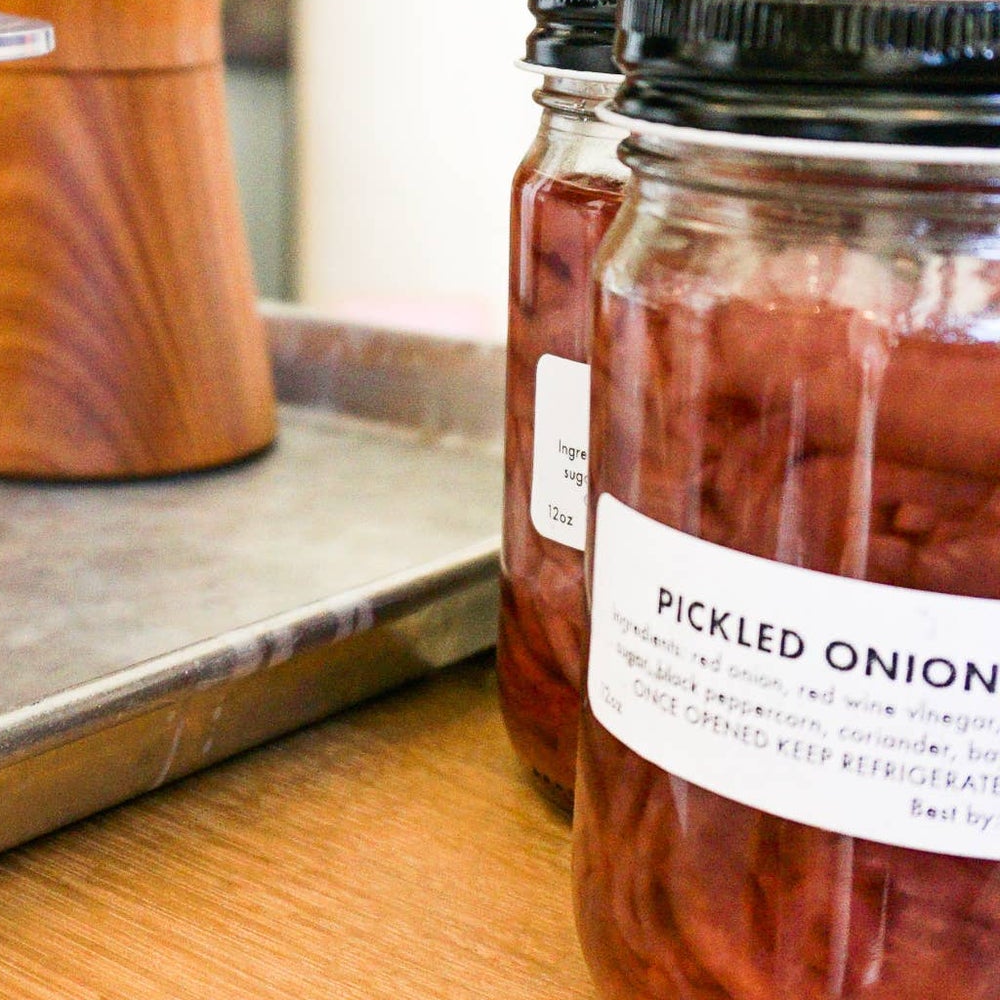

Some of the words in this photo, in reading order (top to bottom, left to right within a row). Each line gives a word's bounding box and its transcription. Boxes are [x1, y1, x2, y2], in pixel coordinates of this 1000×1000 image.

[548, 504, 574, 526] 12oz
[657, 586, 804, 660] PICKLED
[825, 640, 998, 694] ONION
[691, 651, 722, 674] red
[798, 684, 836, 705] red
[845, 692, 896, 716] wine
[633, 679, 677, 718] ONCE
[685, 705, 769, 749] OPENED
[777, 737, 833, 766] KEEP
[910, 798, 957, 821] Best
